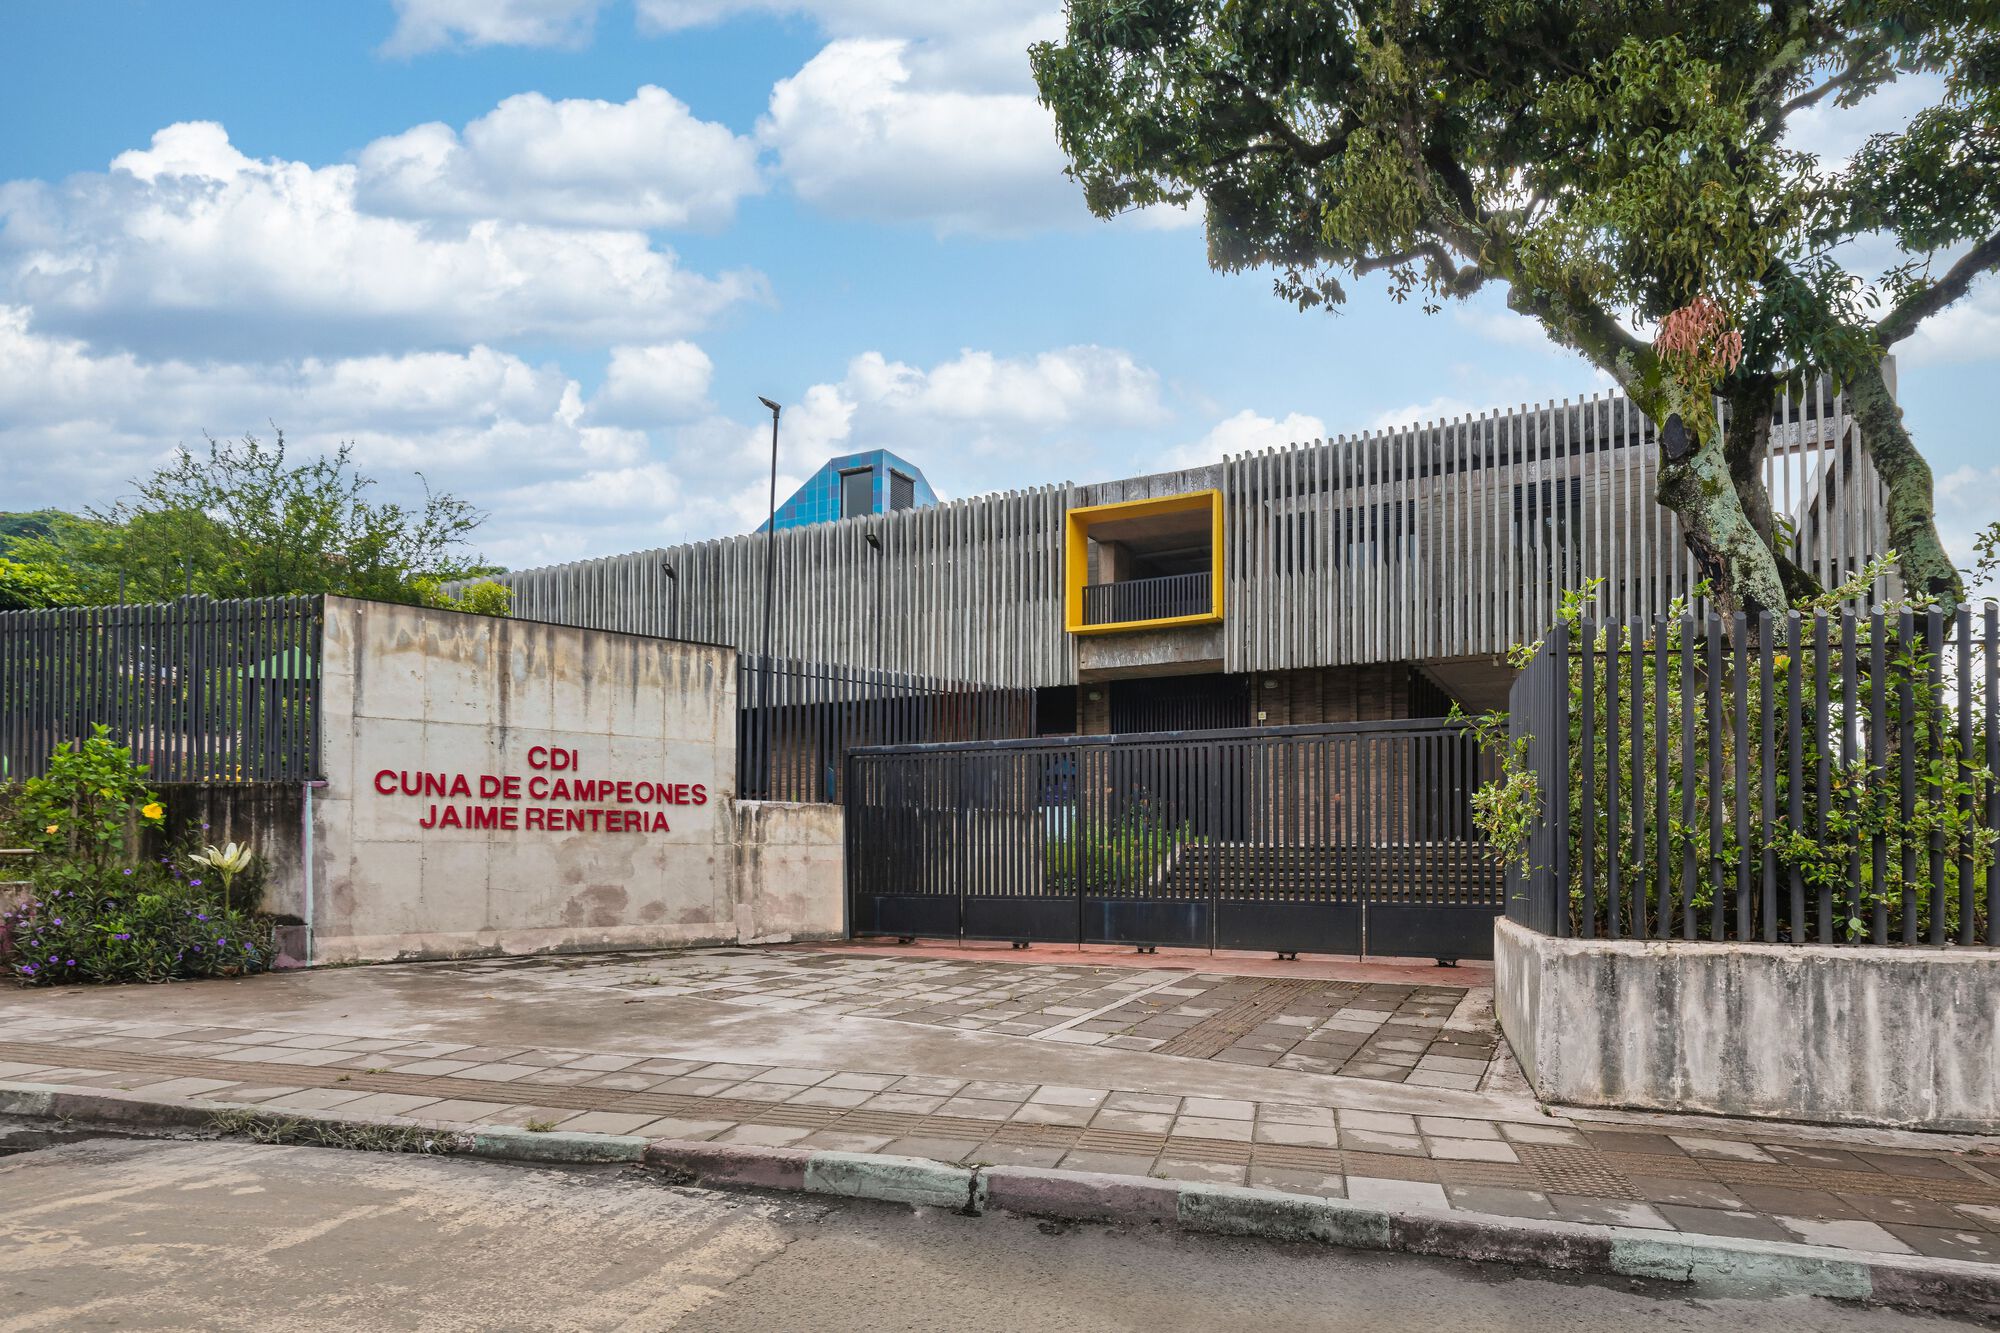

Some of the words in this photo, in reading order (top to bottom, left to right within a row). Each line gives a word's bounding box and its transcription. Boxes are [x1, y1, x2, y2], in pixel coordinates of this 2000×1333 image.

[527, 745, 578, 771] CDI
[373, 769, 472, 798] CUNA
[479, 774, 522, 800] DE
[528, 775, 708, 806] CAMPEONES
[418, 804, 519, 830] JAIME
[525, 807, 670, 833] RENTERIA
